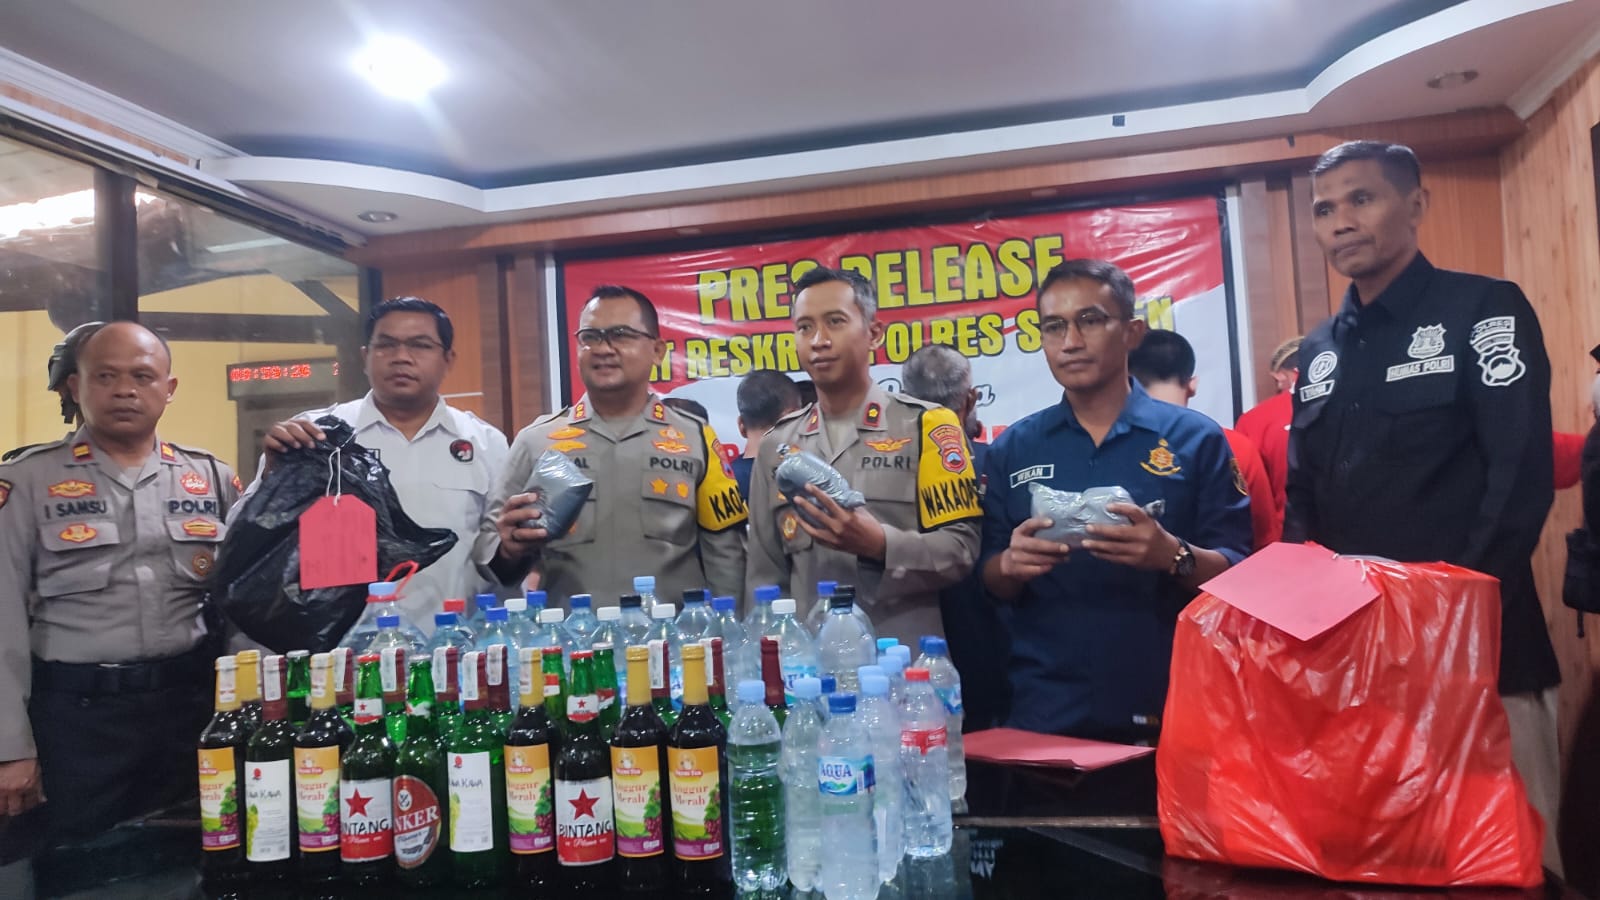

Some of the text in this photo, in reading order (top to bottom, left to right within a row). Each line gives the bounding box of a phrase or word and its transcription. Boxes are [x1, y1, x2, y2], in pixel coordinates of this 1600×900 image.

[686, 332, 801, 380] RESKR
[1423, 359, 1450, 372] POLRI
[650, 457, 694, 474] POLRI
[861, 456, 911, 470] POLRI
[57, 500, 107, 517] SAMSU
[168, 500, 218, 515] POLRI
[820, 762, 852, 781] AQUA
[395, 805, 439, 833] NKER
[558, 820, 612, 837] BINTANG
